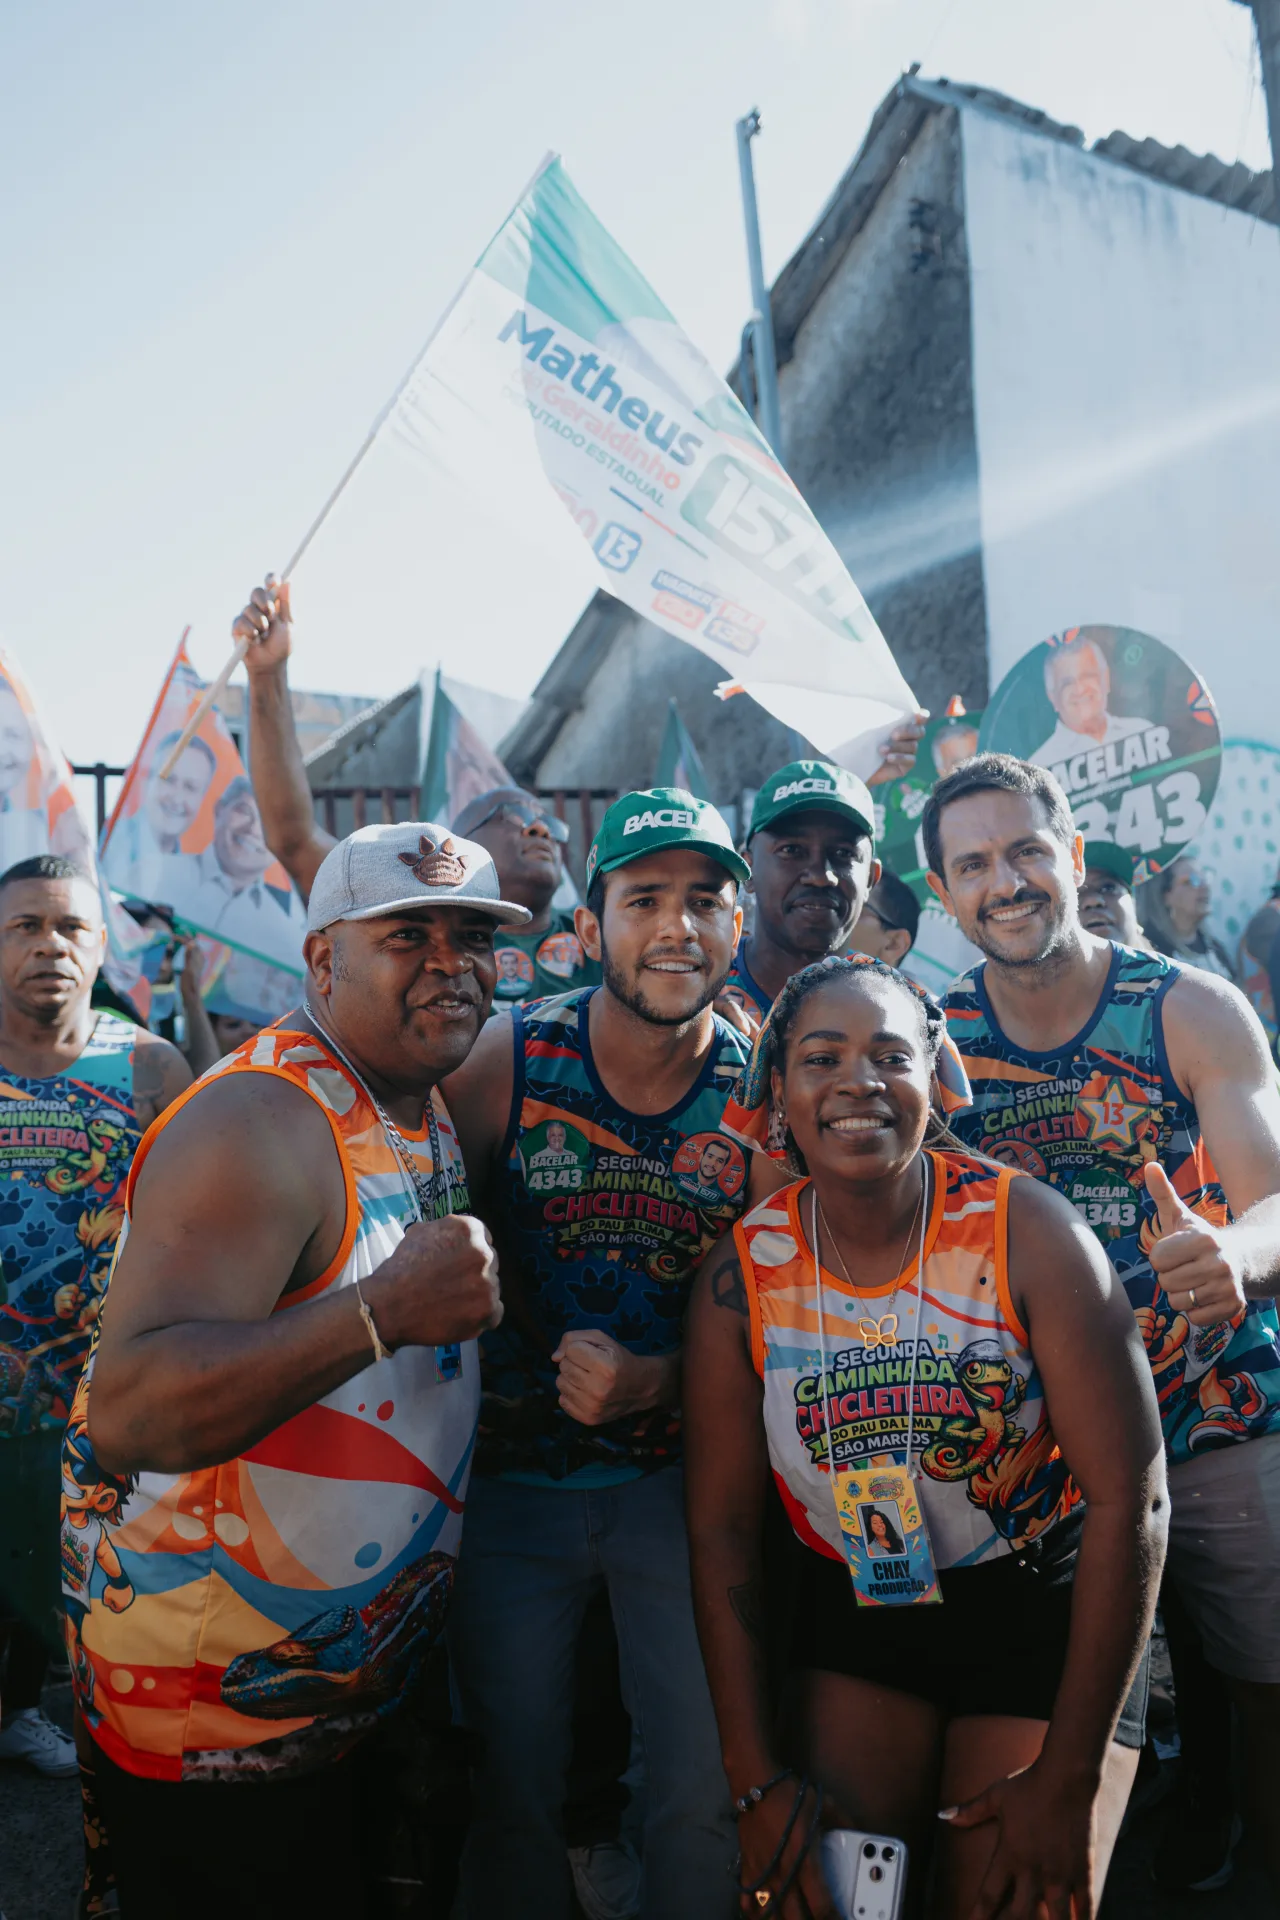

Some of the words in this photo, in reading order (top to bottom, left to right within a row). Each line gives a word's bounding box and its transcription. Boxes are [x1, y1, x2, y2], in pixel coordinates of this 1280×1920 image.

[496, 309, 704, 467] Matheus
[542, 384, 681, 490] Geraldinho
[584, 441, 665, 508] ESTADUAL
[598, 526, 638, 570] 13
[1051, 726, 1172, 793] ACELAR
[773, 779, 839, 802] BACEL
[623, 809, 702, 836] BACEL
[1070, 771, 1206, 853] 343
[0, 1100, 71, 1111] SEGUNDA
[984, 1094, 1077, 1133] CAMINH
[1102, 1102, 1124, 1126] 13
[0, 1111, 86, 1130] MINHADA
[0, 1127, 90, 1153] CLETEIRA
[1070, 1143, 1098, 1153] LIMA
[11, 1158, 57, 1168] MARCOS
[529, 1154, 579, 1169] BACELAR
[1051, 1155, 1094, 1167] ARCOS
[528, 1168, 583, 1190] 4343
[577, 1171, 681, 1201] AMINHAD
[1072, 1184, 1130, 1198] BACELAR
[543, 1192, 699, 1236] CHICLETEIRA
[579, 1232, 606, 1245] SÃO
[608, 1233, 661, 1248] MARCOS
[580, 1220, 596, 1231] DO
[598, 1220, 621, 1230] PAU
[638, 1222, 666, 1240] LIMA
[836, 1341, 932, 1370] SEGUNDA
[797, 1359, 959, 1403] CAMINHADA
[797, 1384, 976, 1437] CHICLETEIRA
[832, 1429, 849, 1442] DO
[851, 1421, 876, 1436] PAU
[879, 1418, 897, 1430] DA
[901, 1418, 935, 1430] LMA
[835, 1441, 865, 1458] SÃO
[867, 1433, 931, 1450] MARCOS
[872, 1560, 911, 1581] CHAY
[868, 1577, 926, 1597] PRODUÇÃO
